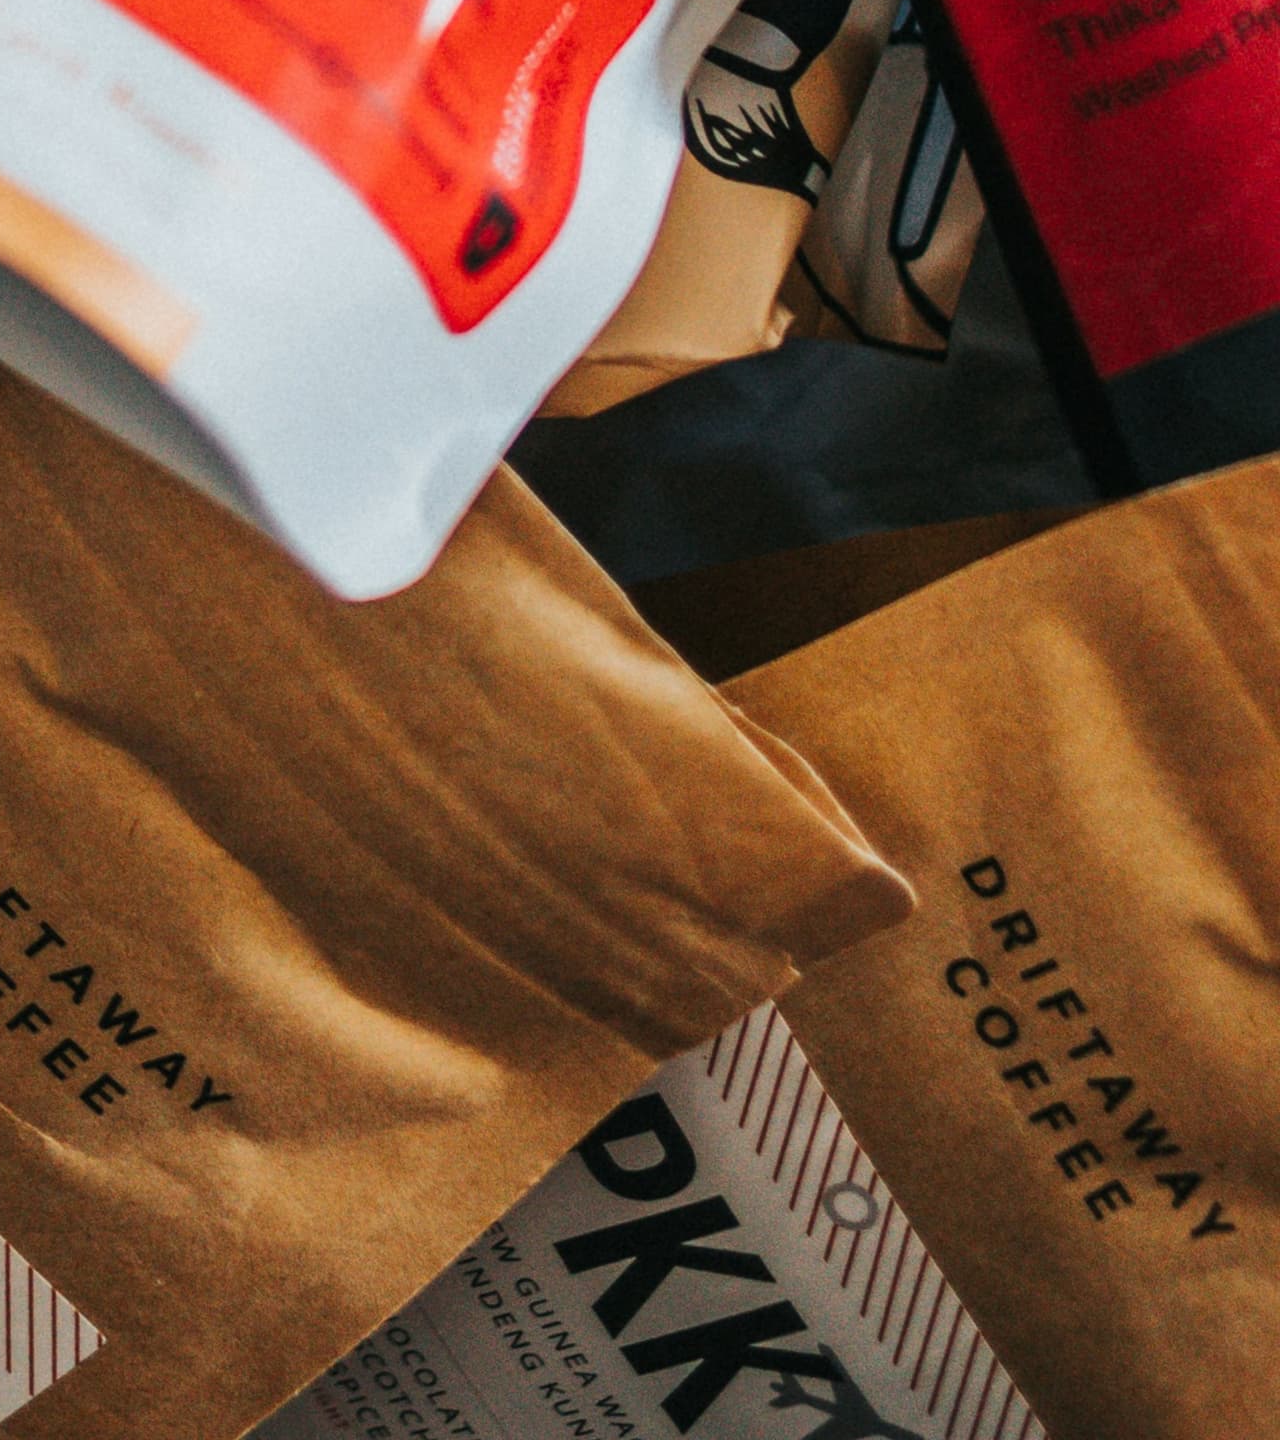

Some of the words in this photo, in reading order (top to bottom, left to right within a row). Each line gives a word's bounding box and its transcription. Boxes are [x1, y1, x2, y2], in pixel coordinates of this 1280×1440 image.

[942, 955, 1134, 1223] COFFEE
[959, 852, 1236, 1245] DRIFTAWAY
[514, 1276, 599, 1389] GUINEA
